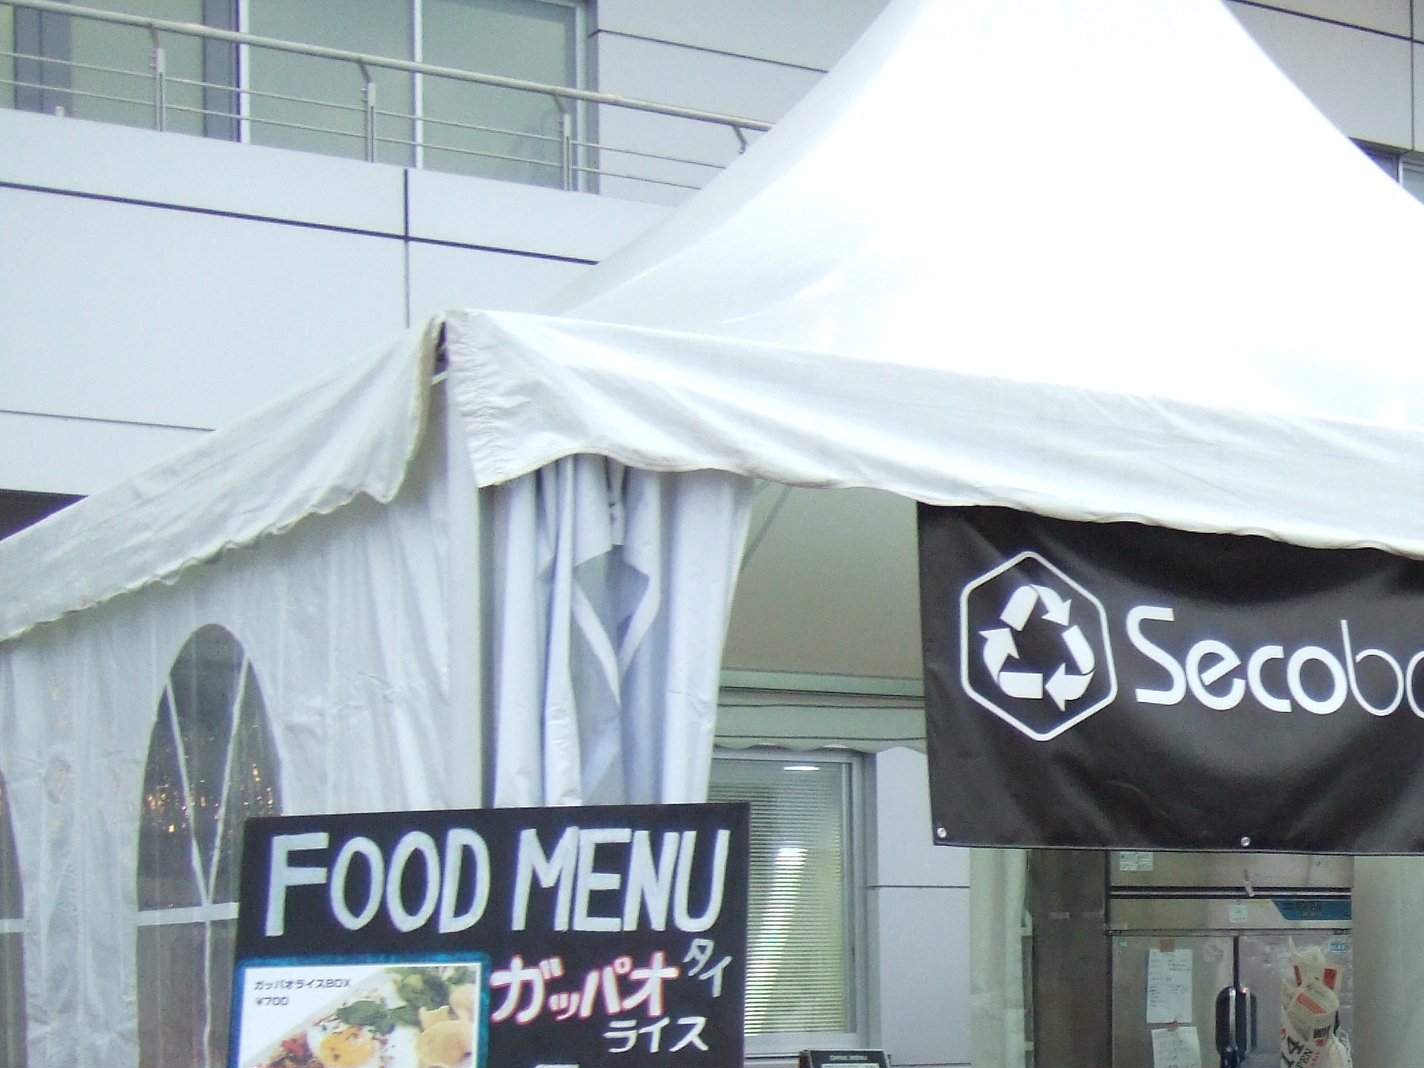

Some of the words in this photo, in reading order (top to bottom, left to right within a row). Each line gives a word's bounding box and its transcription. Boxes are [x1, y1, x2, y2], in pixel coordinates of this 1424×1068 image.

[265, 828, 491, 937] FOOD
[511, 826, 731, 932] MENU
[604, 1017, 708, 1054] ライス
